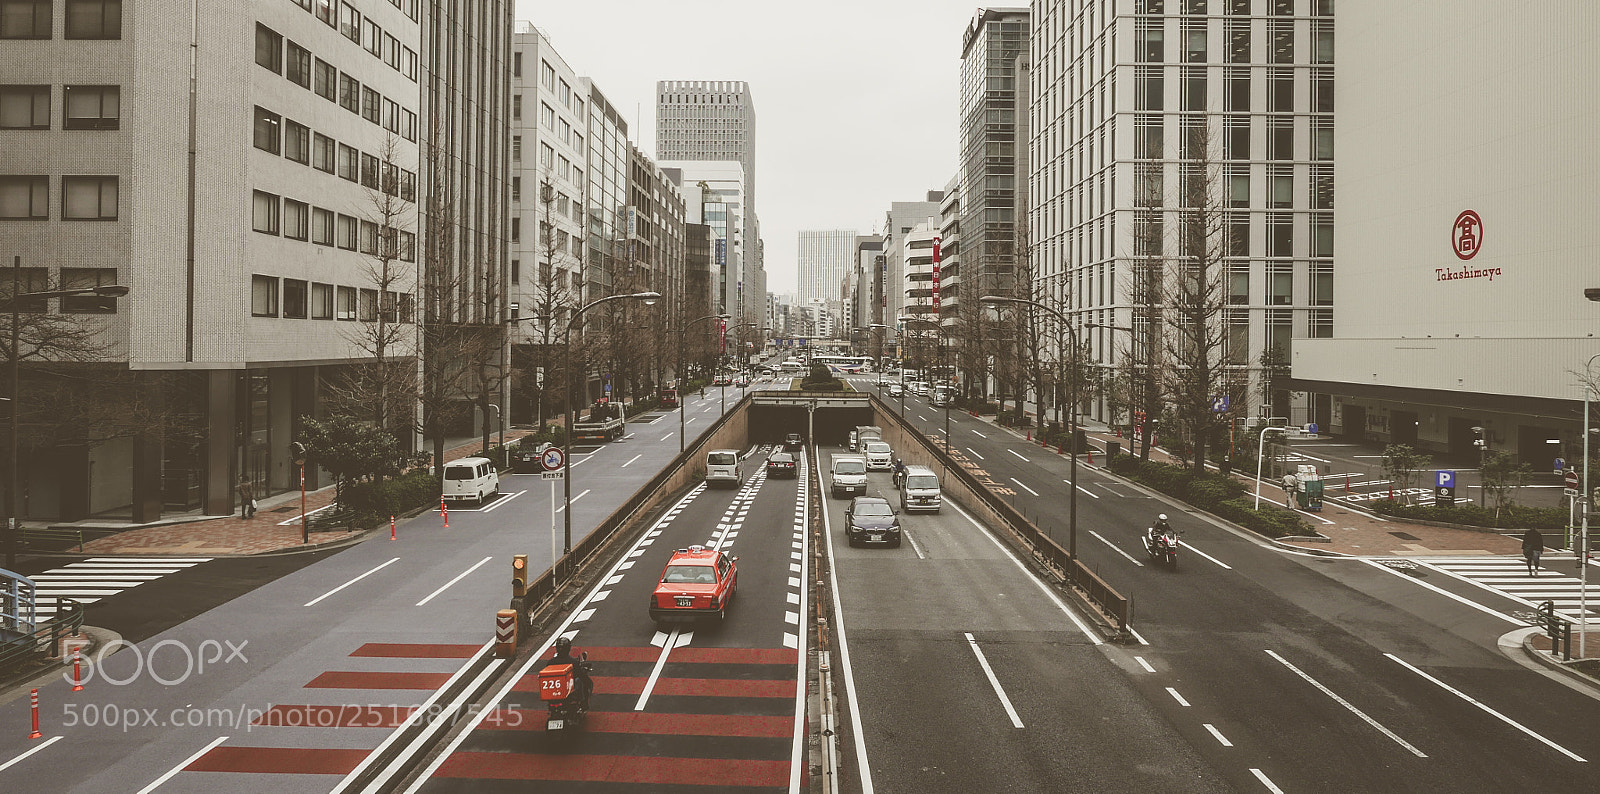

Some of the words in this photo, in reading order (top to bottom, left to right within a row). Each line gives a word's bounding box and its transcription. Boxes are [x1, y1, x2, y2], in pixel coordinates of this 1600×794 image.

[1435, 266, 1502, 282] Takashimaya
[1439, 472, 1451, 485] P
[542, 679, 561, 690] 226
